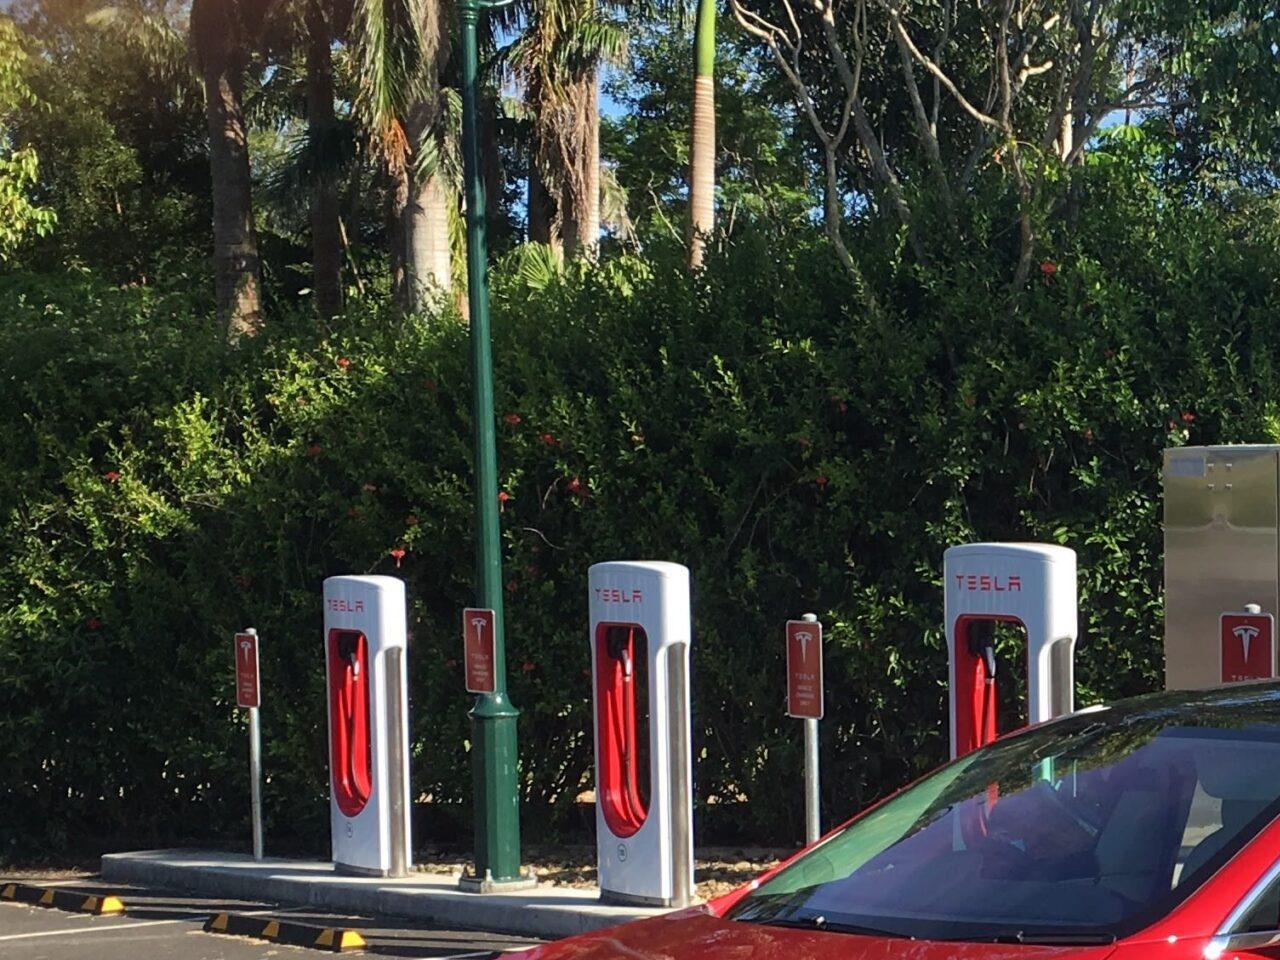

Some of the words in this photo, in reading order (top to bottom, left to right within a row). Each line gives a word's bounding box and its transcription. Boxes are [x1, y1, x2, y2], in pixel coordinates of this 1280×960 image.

[955, 575, 1021, 591] TESLA
[595, 588, 642, 603] TESLA
[327, 599, 364, 612] TESLA
